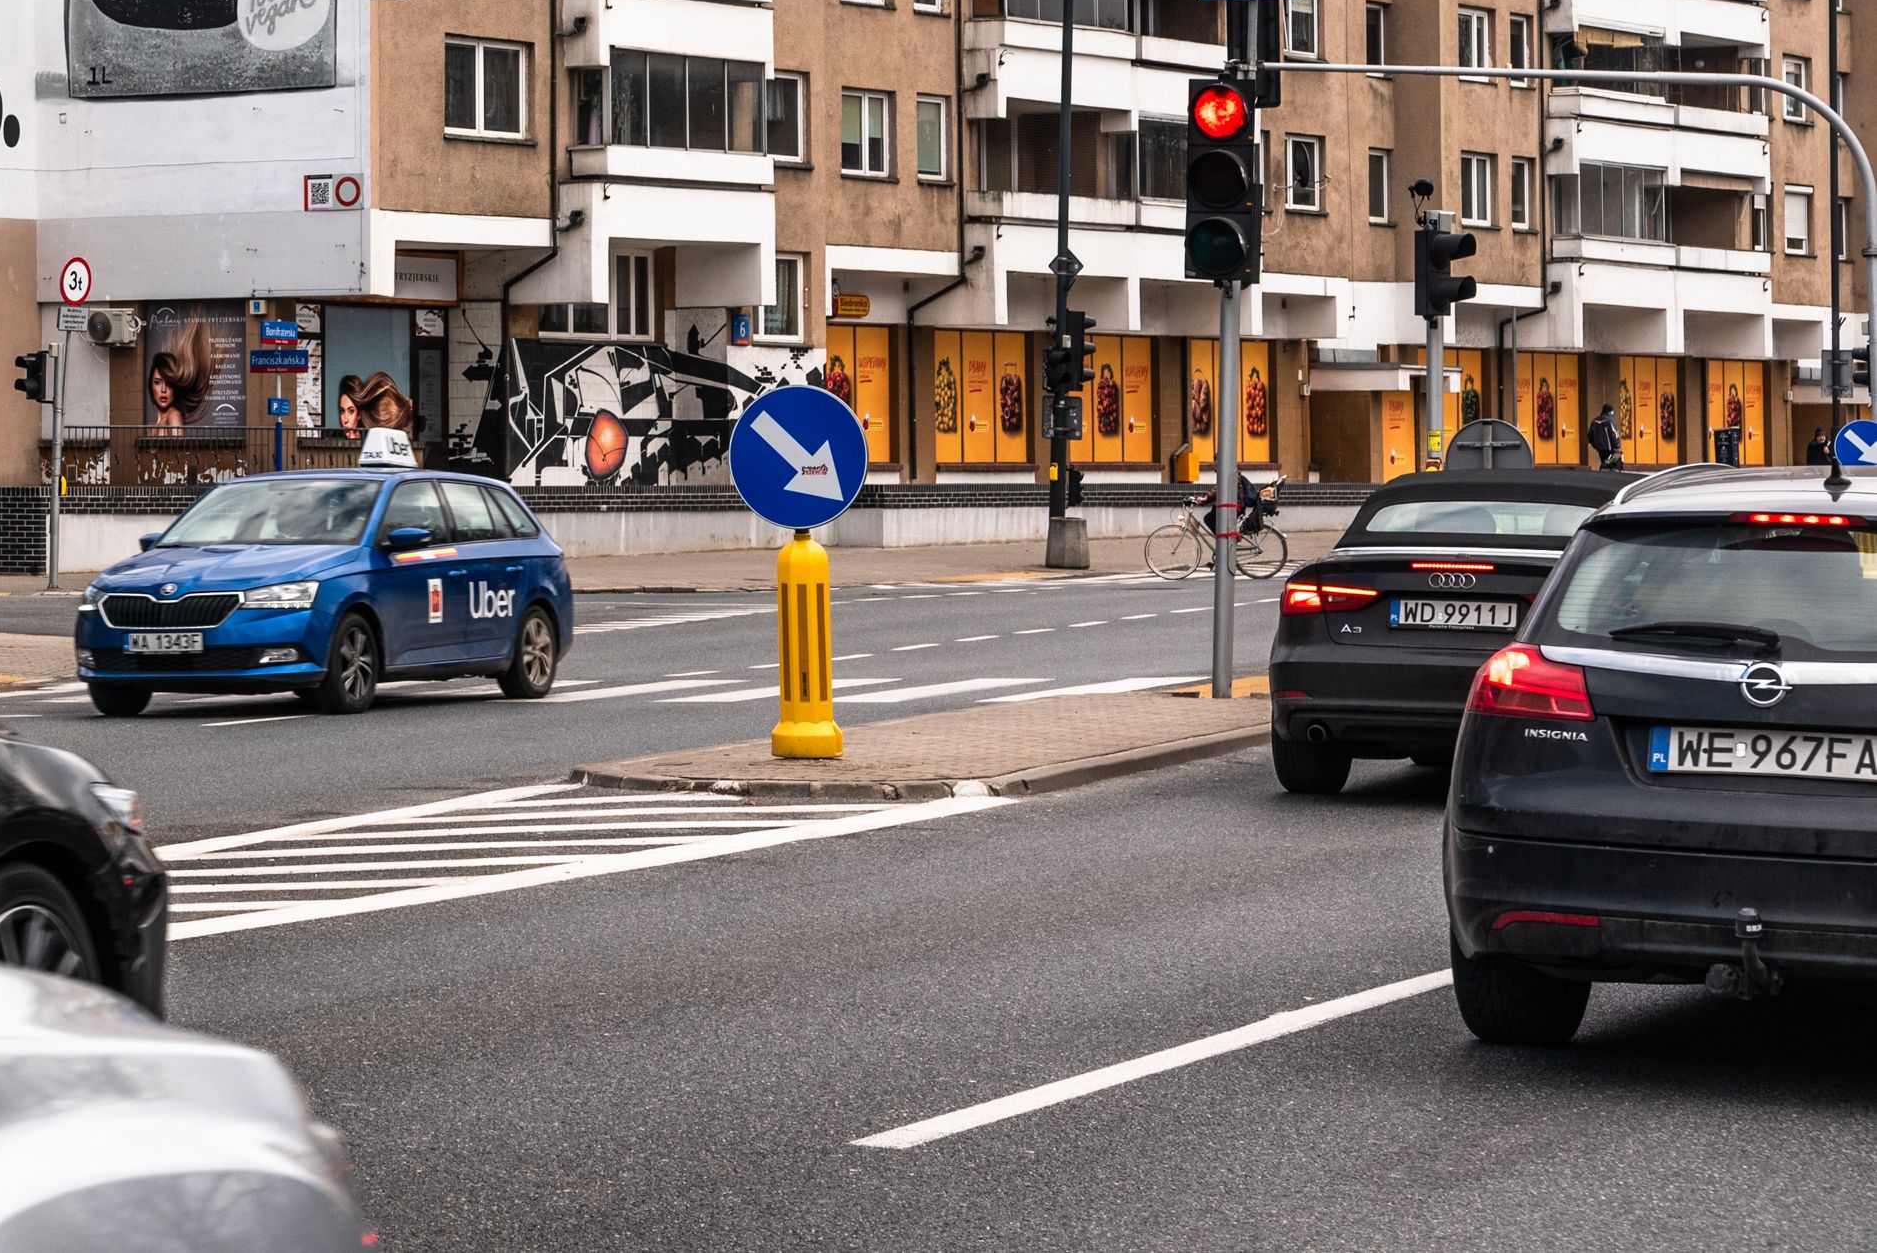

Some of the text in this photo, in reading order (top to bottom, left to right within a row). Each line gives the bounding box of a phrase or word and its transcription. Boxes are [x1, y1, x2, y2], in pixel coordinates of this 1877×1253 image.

[86, 66, 113, 85] 1L
[839, 298, 868, 307] Biedronka
[740, 321, 746, 338] 6
[251, 355, 305, 365] Franciszkańska
[385, 436, 409, 456] Uber
[469, 581, 516, 619] Uber
[1405, 602, 1512, 625] WD 9911J
[1340, 624, 1362, 633] A3
[129, 634, 200, 650] WA 1343F
[1524, 728, 1588, 742] INSIGNIA
[1653, 752, 1666, 763] PL
[1677, 730, 1877, 776] WE 967FA
